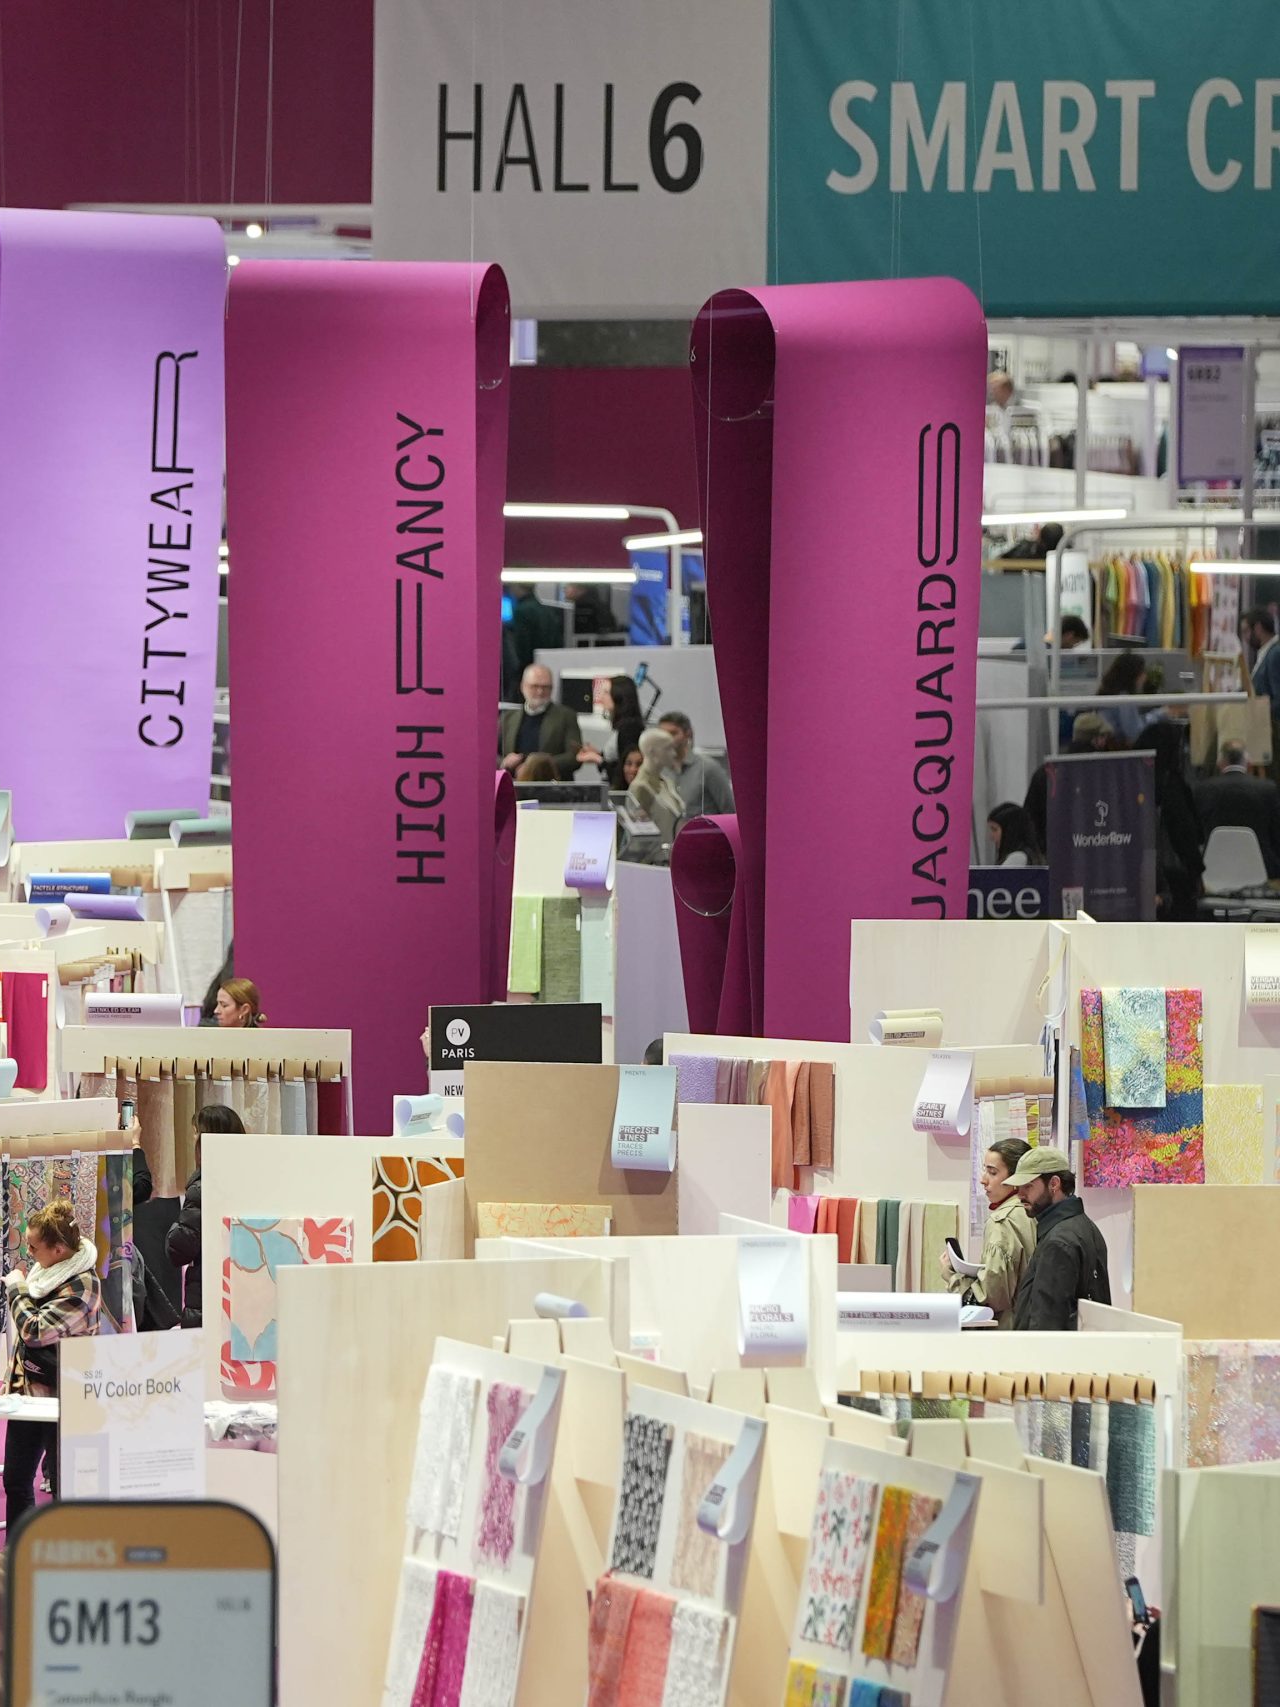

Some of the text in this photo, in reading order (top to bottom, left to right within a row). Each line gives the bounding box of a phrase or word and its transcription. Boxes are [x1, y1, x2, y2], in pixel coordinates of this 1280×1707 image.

[826, 78, 1156, 195] SMART
[138, 349, 199, 748] CITYWEAR
[394, 411, 446, 885] HIGH FANCY
[911, 421, 961, 919] JACQUARDS
[1072, 831, 1132, 848] WonderRaw
[451, 1028, 465, 1038] PV
[441, 1048, 475, 1059] PARIS
[444, 1085, 464, 1096] NEW
[917, 1110, 944, 1118] SHINES
[618, 1126, 658, 1134] PRECISE
[618, 1134, 647, 1142] LINES
[750, 1312, 792, 1322] FLORALS
[84, 1370, 93, 1380] SS
[83, 1376, 181, 1400] PV Color Book
[32, 1538, 116, 1565] FABRICS
[48, 1598, 161, 1646] 6M13
